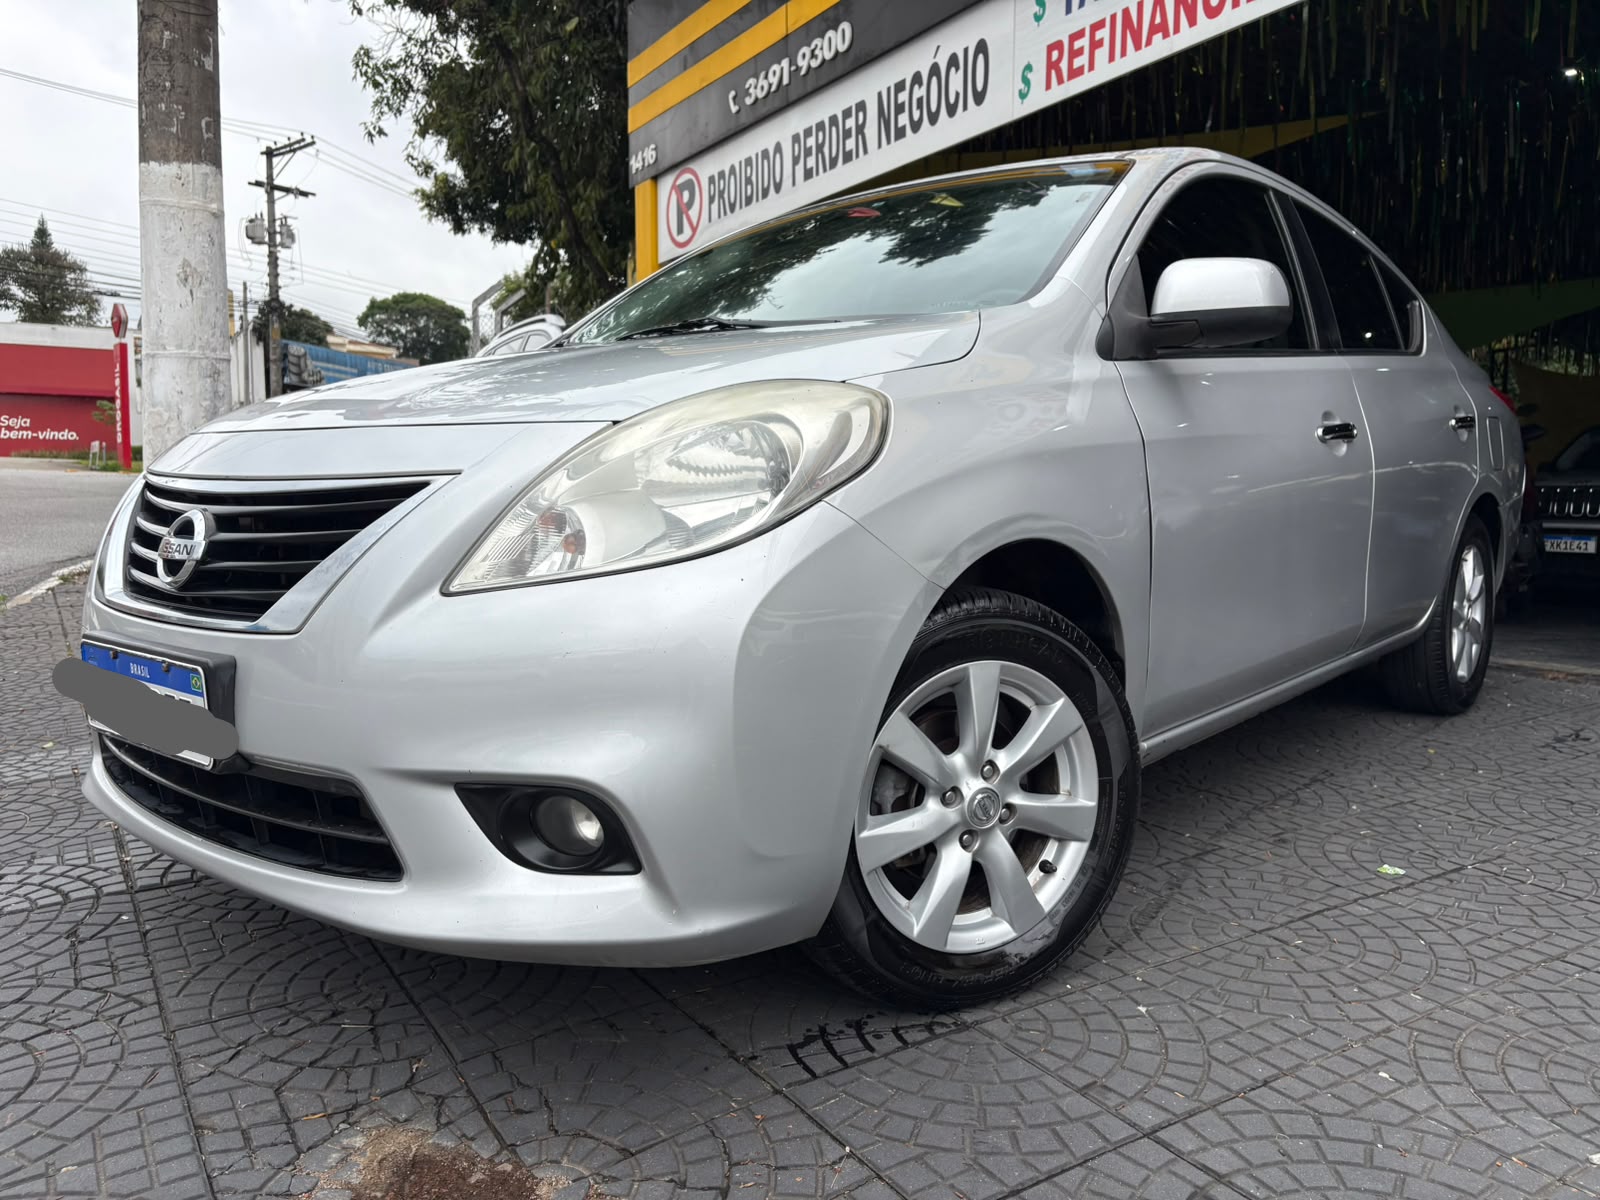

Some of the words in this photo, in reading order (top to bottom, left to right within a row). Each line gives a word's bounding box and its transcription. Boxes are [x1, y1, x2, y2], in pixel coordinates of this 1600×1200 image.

[745, 21, 853, 106] 3691-9300
[1018, 61, 1033, 104] $
[708, 140, 784, 223] PROIBIDO
[792, 99, 868, 187] PERDER
[877, 38, 990, 149] NEGÓCIO
[630, 143, 657, 175] 1416
[0, 415, 31, 429] Seja
[0, 427, 79, 440] bem-vindo.
[130, 662, 150, 679] BRASIL
